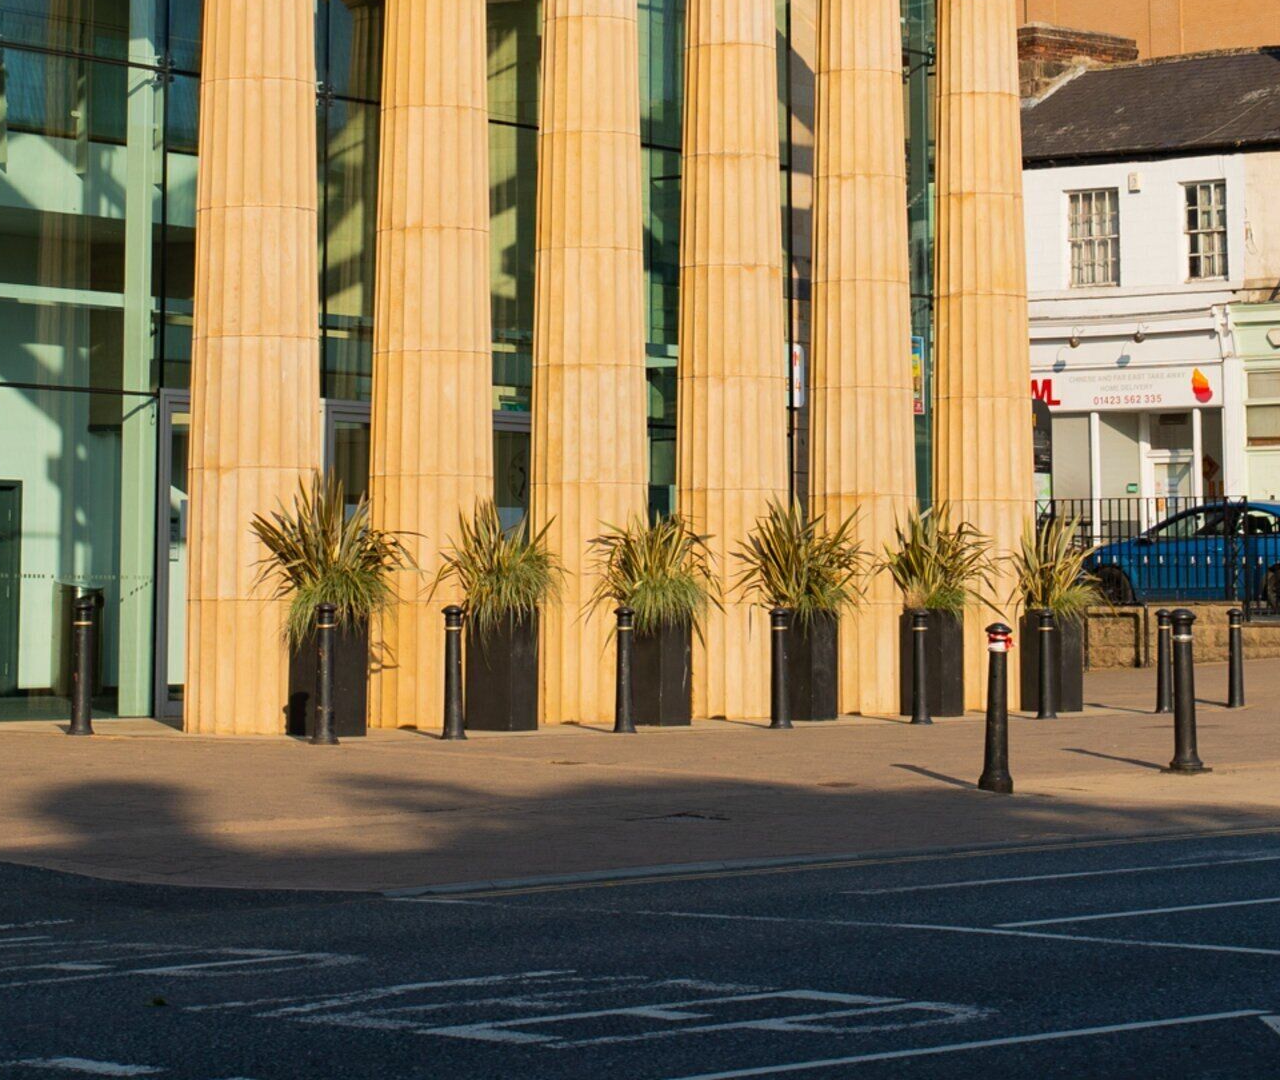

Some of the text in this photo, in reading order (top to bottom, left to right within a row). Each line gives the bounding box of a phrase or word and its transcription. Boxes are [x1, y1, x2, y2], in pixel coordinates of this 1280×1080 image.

[1068, 375, 1097, 384] CHINESE
[1098, 374, 1113, 383] AND
[1128, 372, 1145, 381] EAST
[1148, 372, 1164, 380] TAKE
[1166, 371, 1186, 380] AWAY
[1100, 383, 1153, 392] HOME DELIVERY
[1093, 393, 1162, 406] 01423 562 335
[183, 970, 999, 1049] KEEP
